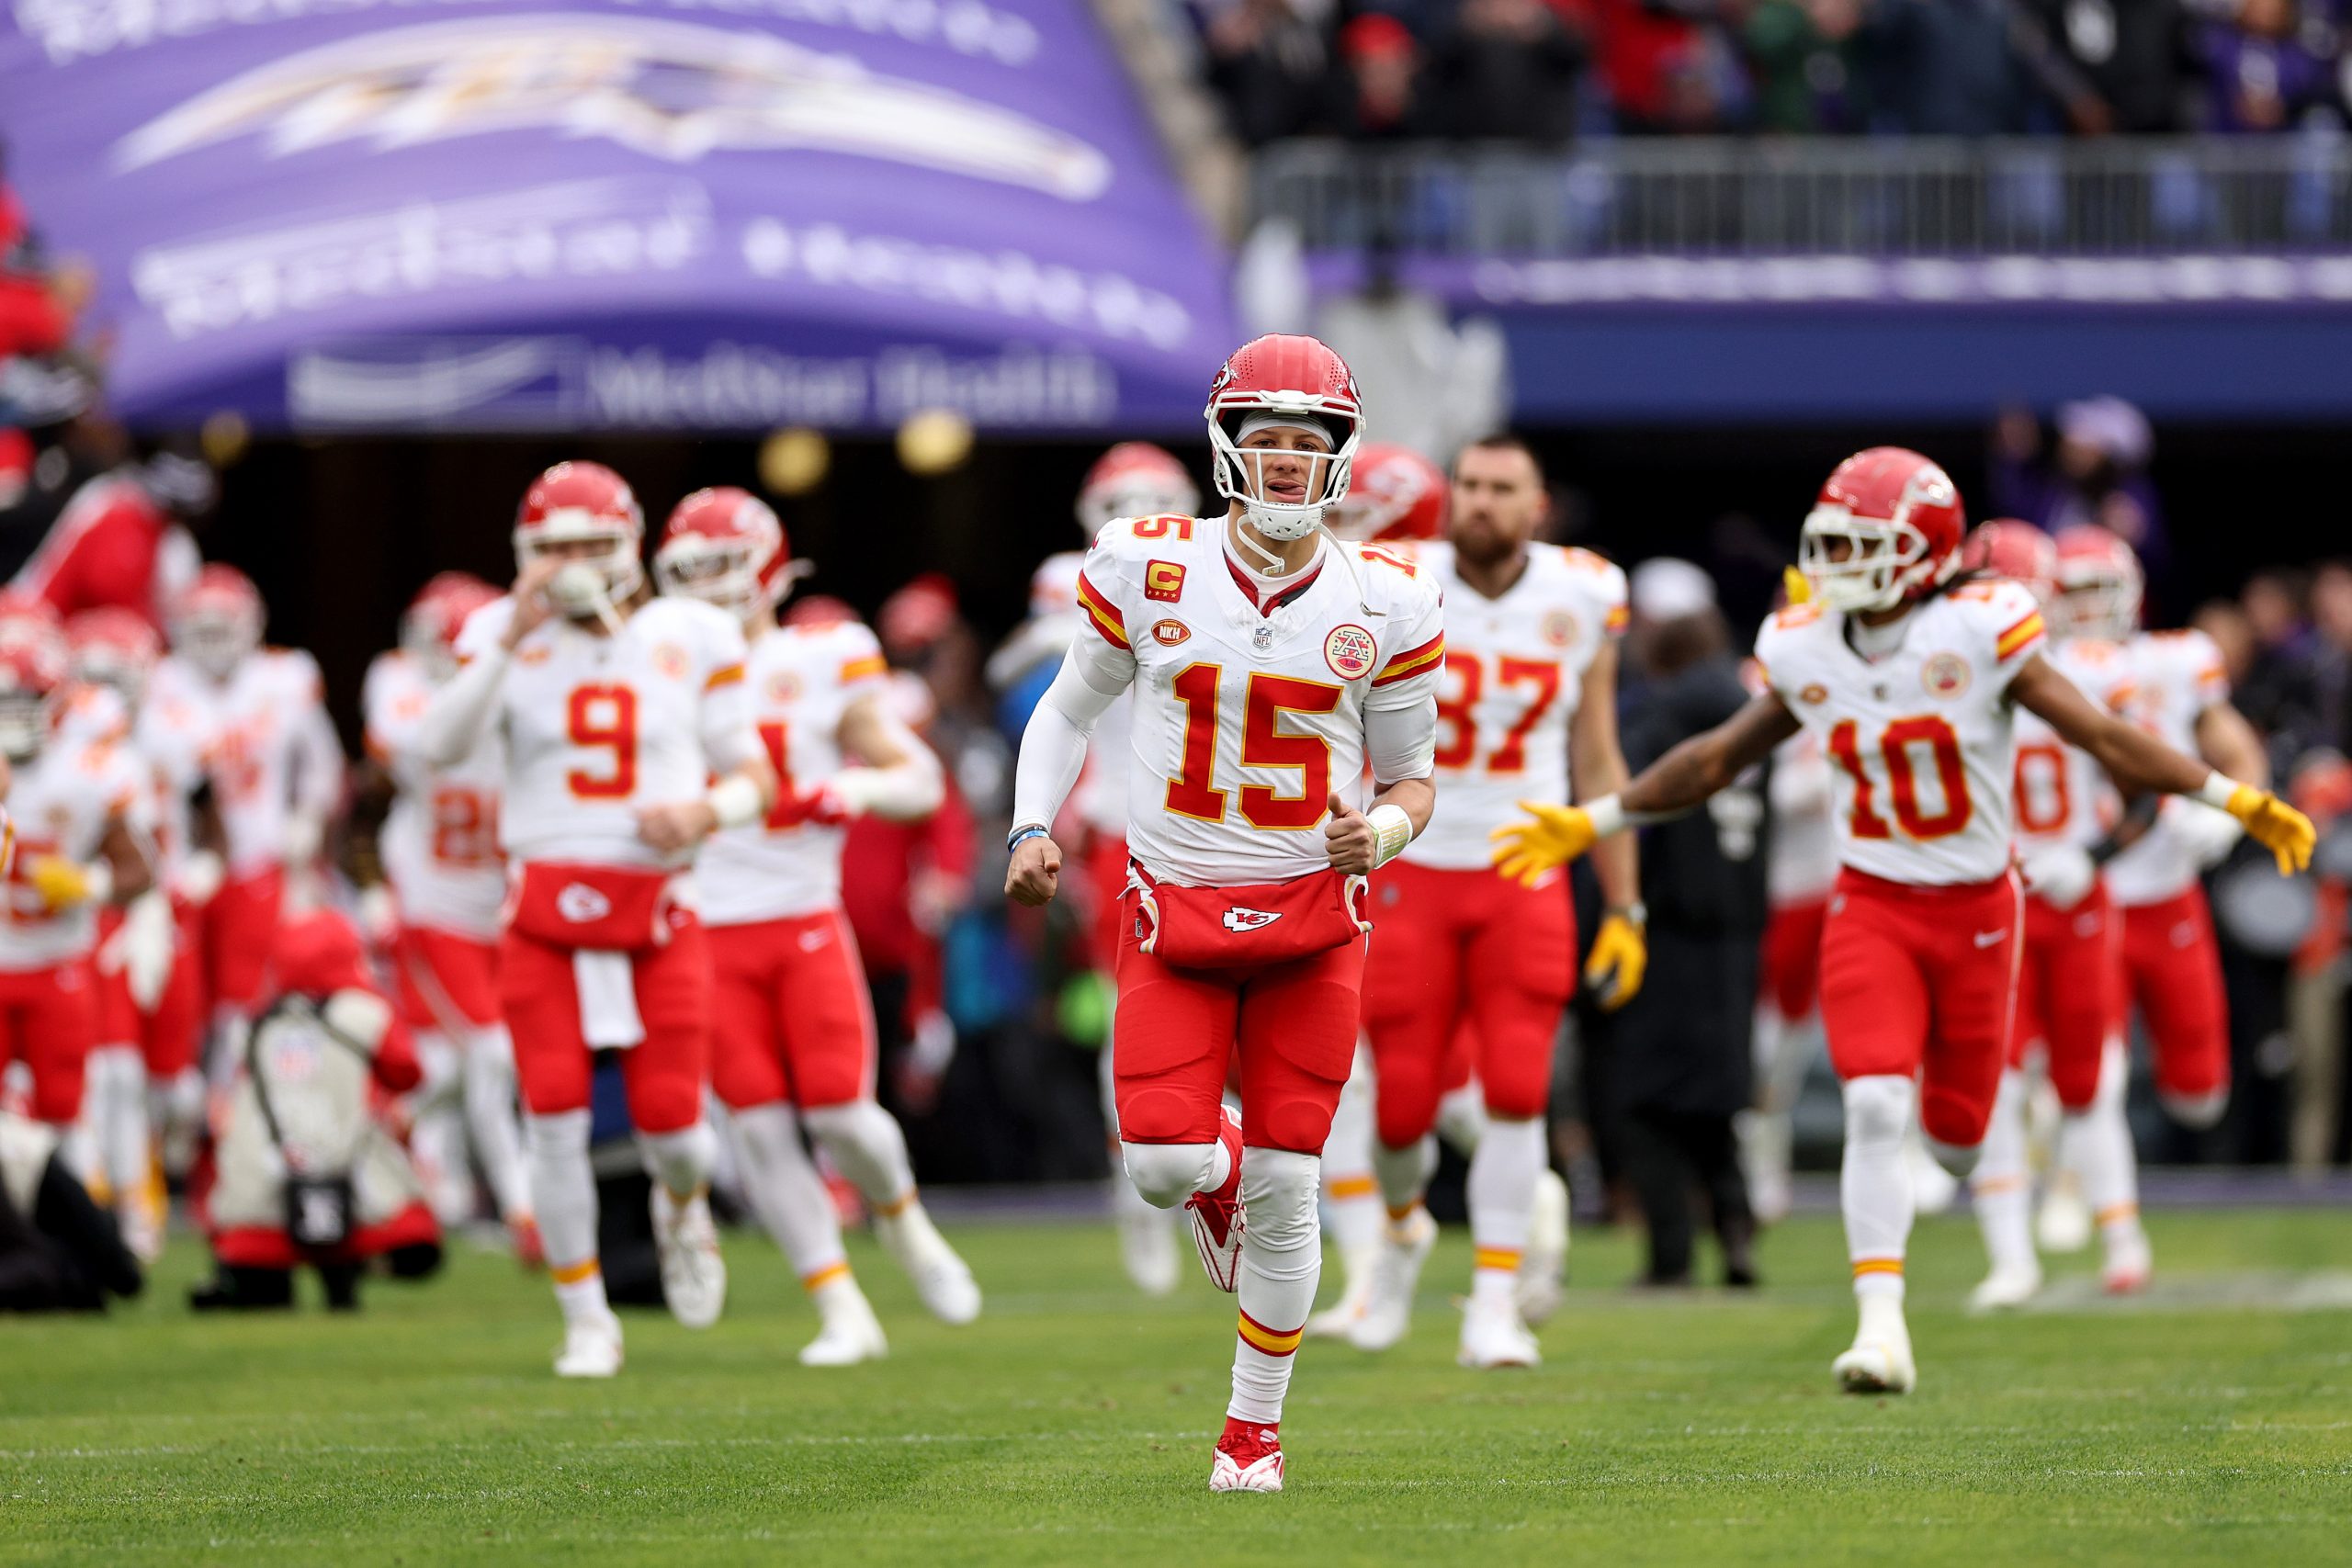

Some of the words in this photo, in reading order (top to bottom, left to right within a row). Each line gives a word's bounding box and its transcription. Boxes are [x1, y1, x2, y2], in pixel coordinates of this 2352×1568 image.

[1148, 562, 1182, 592] C
[1159, 625, 1182, 640] NKH
[1255, 635, 1271, 647] NFL
[1332, 630, 1369, 661] A
[566, 681, 638, 799] 9
[1163, 661, 1345, 831] 15
[1829, 715, 1973, 840] 10
